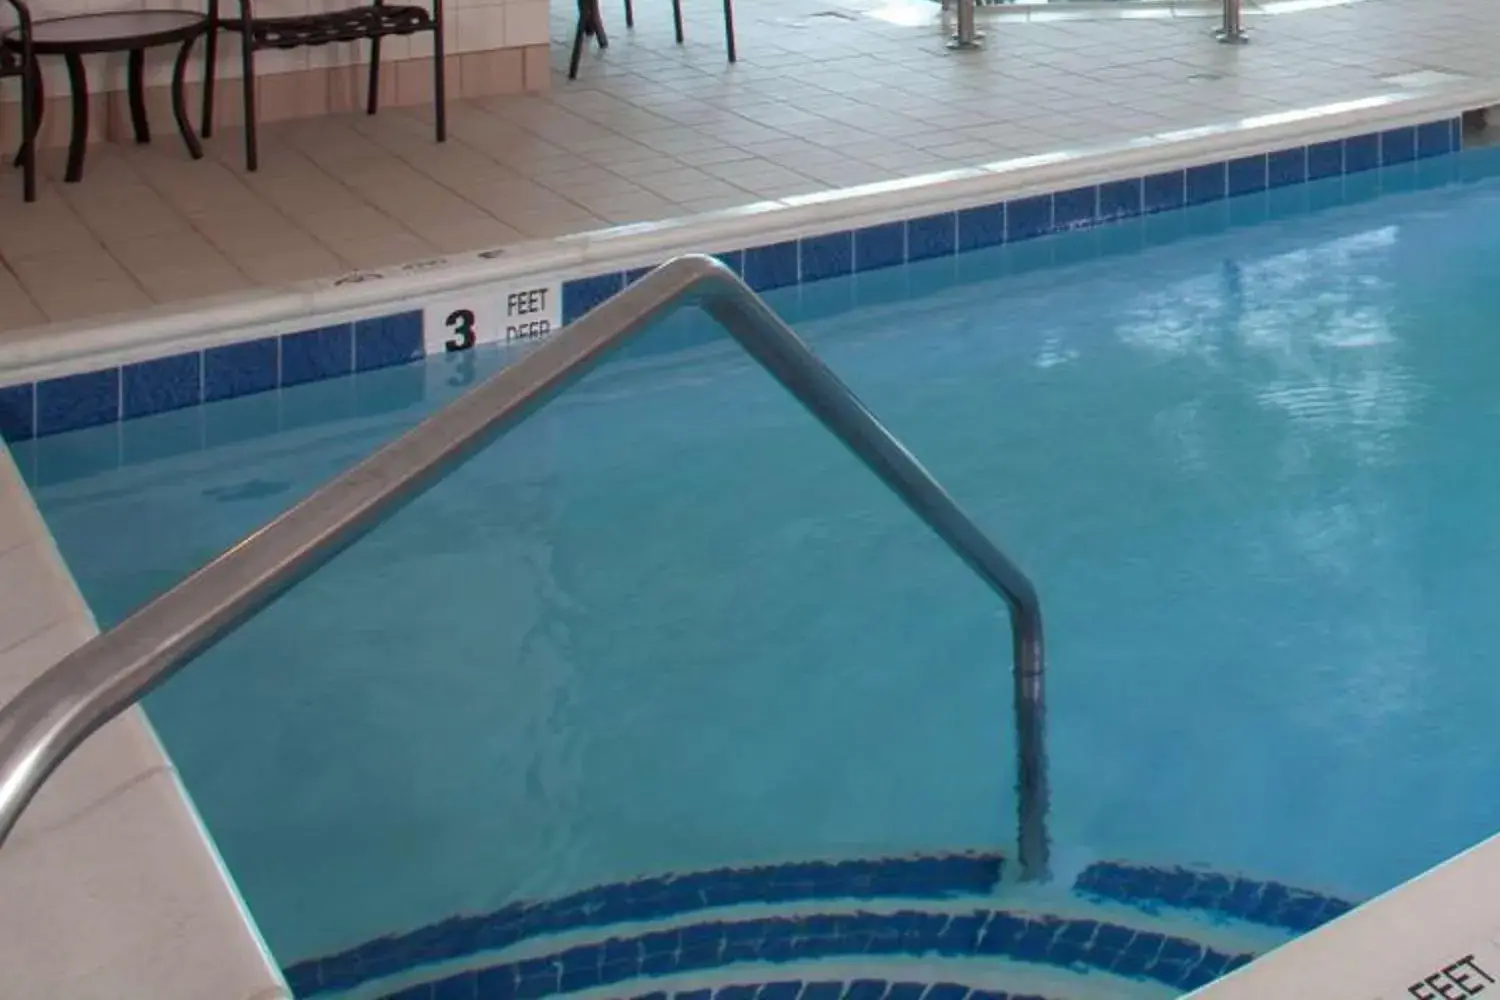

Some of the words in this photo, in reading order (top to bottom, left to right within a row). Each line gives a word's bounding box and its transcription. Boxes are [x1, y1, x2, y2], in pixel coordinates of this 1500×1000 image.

[445, 308, 477, 352] 3
[507, 287, 548, 317] FEET
[1407, 954, 1496, 1000] FEET
